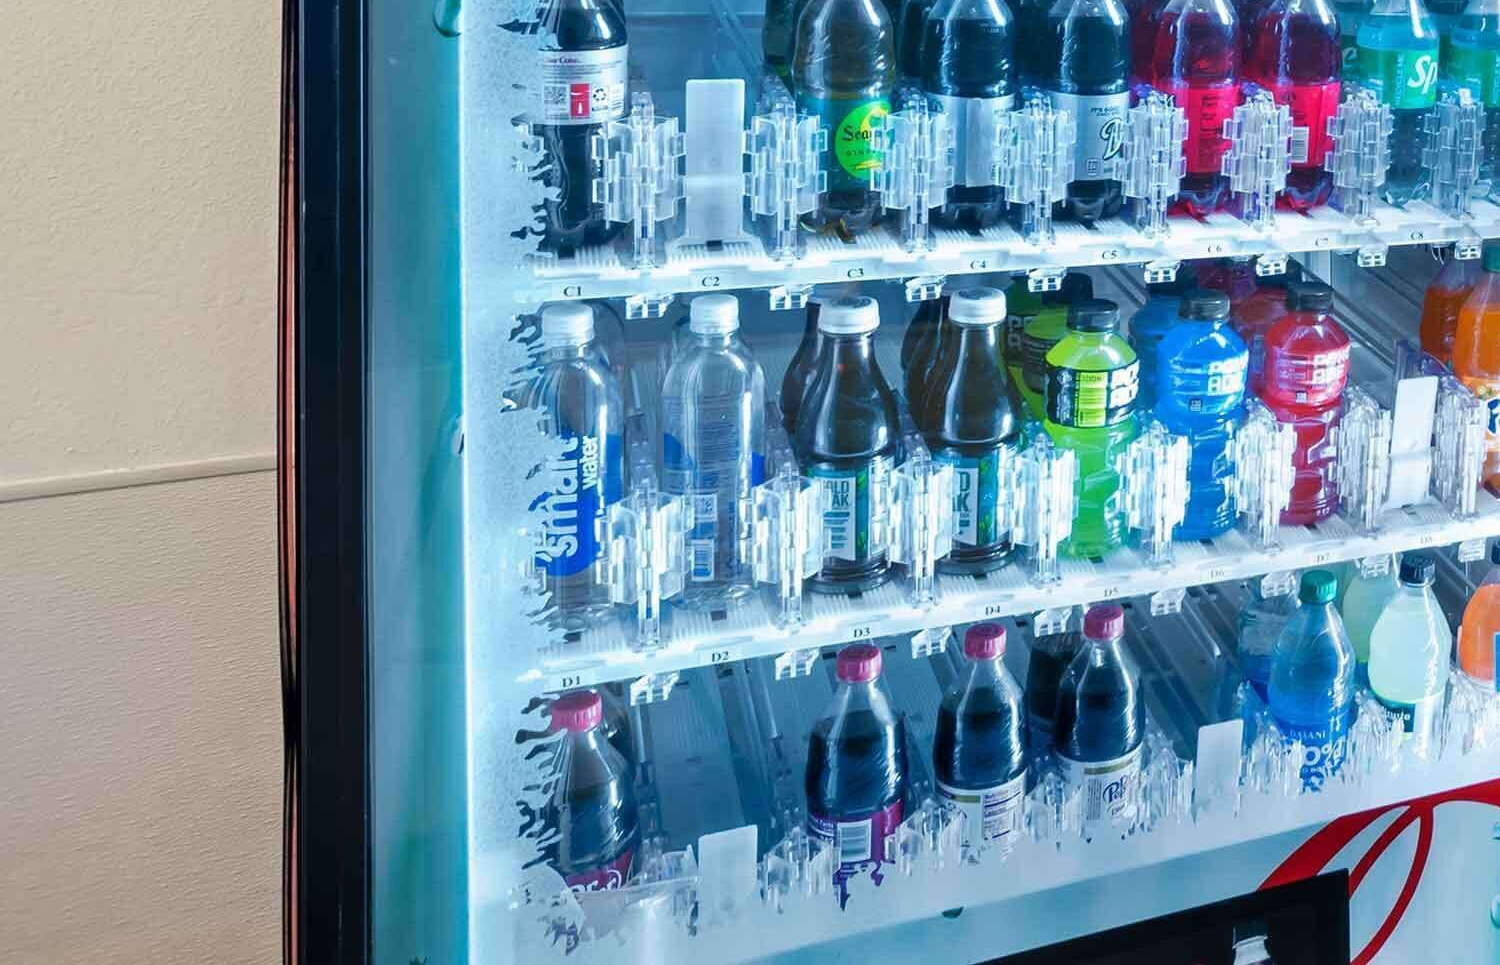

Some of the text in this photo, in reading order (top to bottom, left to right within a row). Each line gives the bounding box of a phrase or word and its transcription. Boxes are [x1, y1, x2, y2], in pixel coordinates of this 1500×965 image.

[563, 285, 582, 297] C1
[702, 276, 720, 287] C2
[847, 268, 864, 279] C3
[970, 260, 986, 271] C4
[1101, 249, 1117, 260] C5
[1208, 243, 1222, 253] C6
[1410, 230, 1424, 240] C8
[580, 435, 598, 491] water
[824, 479, 849, 494] OLD
[831, 494, 849, 508] AK
[562, 676, 580, 687] D1
[711, 651, 729, 662] D2
[853, 627, 870, 638] D3
[985, 605, 1000, 616] D4
[1103, 587, 1118, 597] D5
